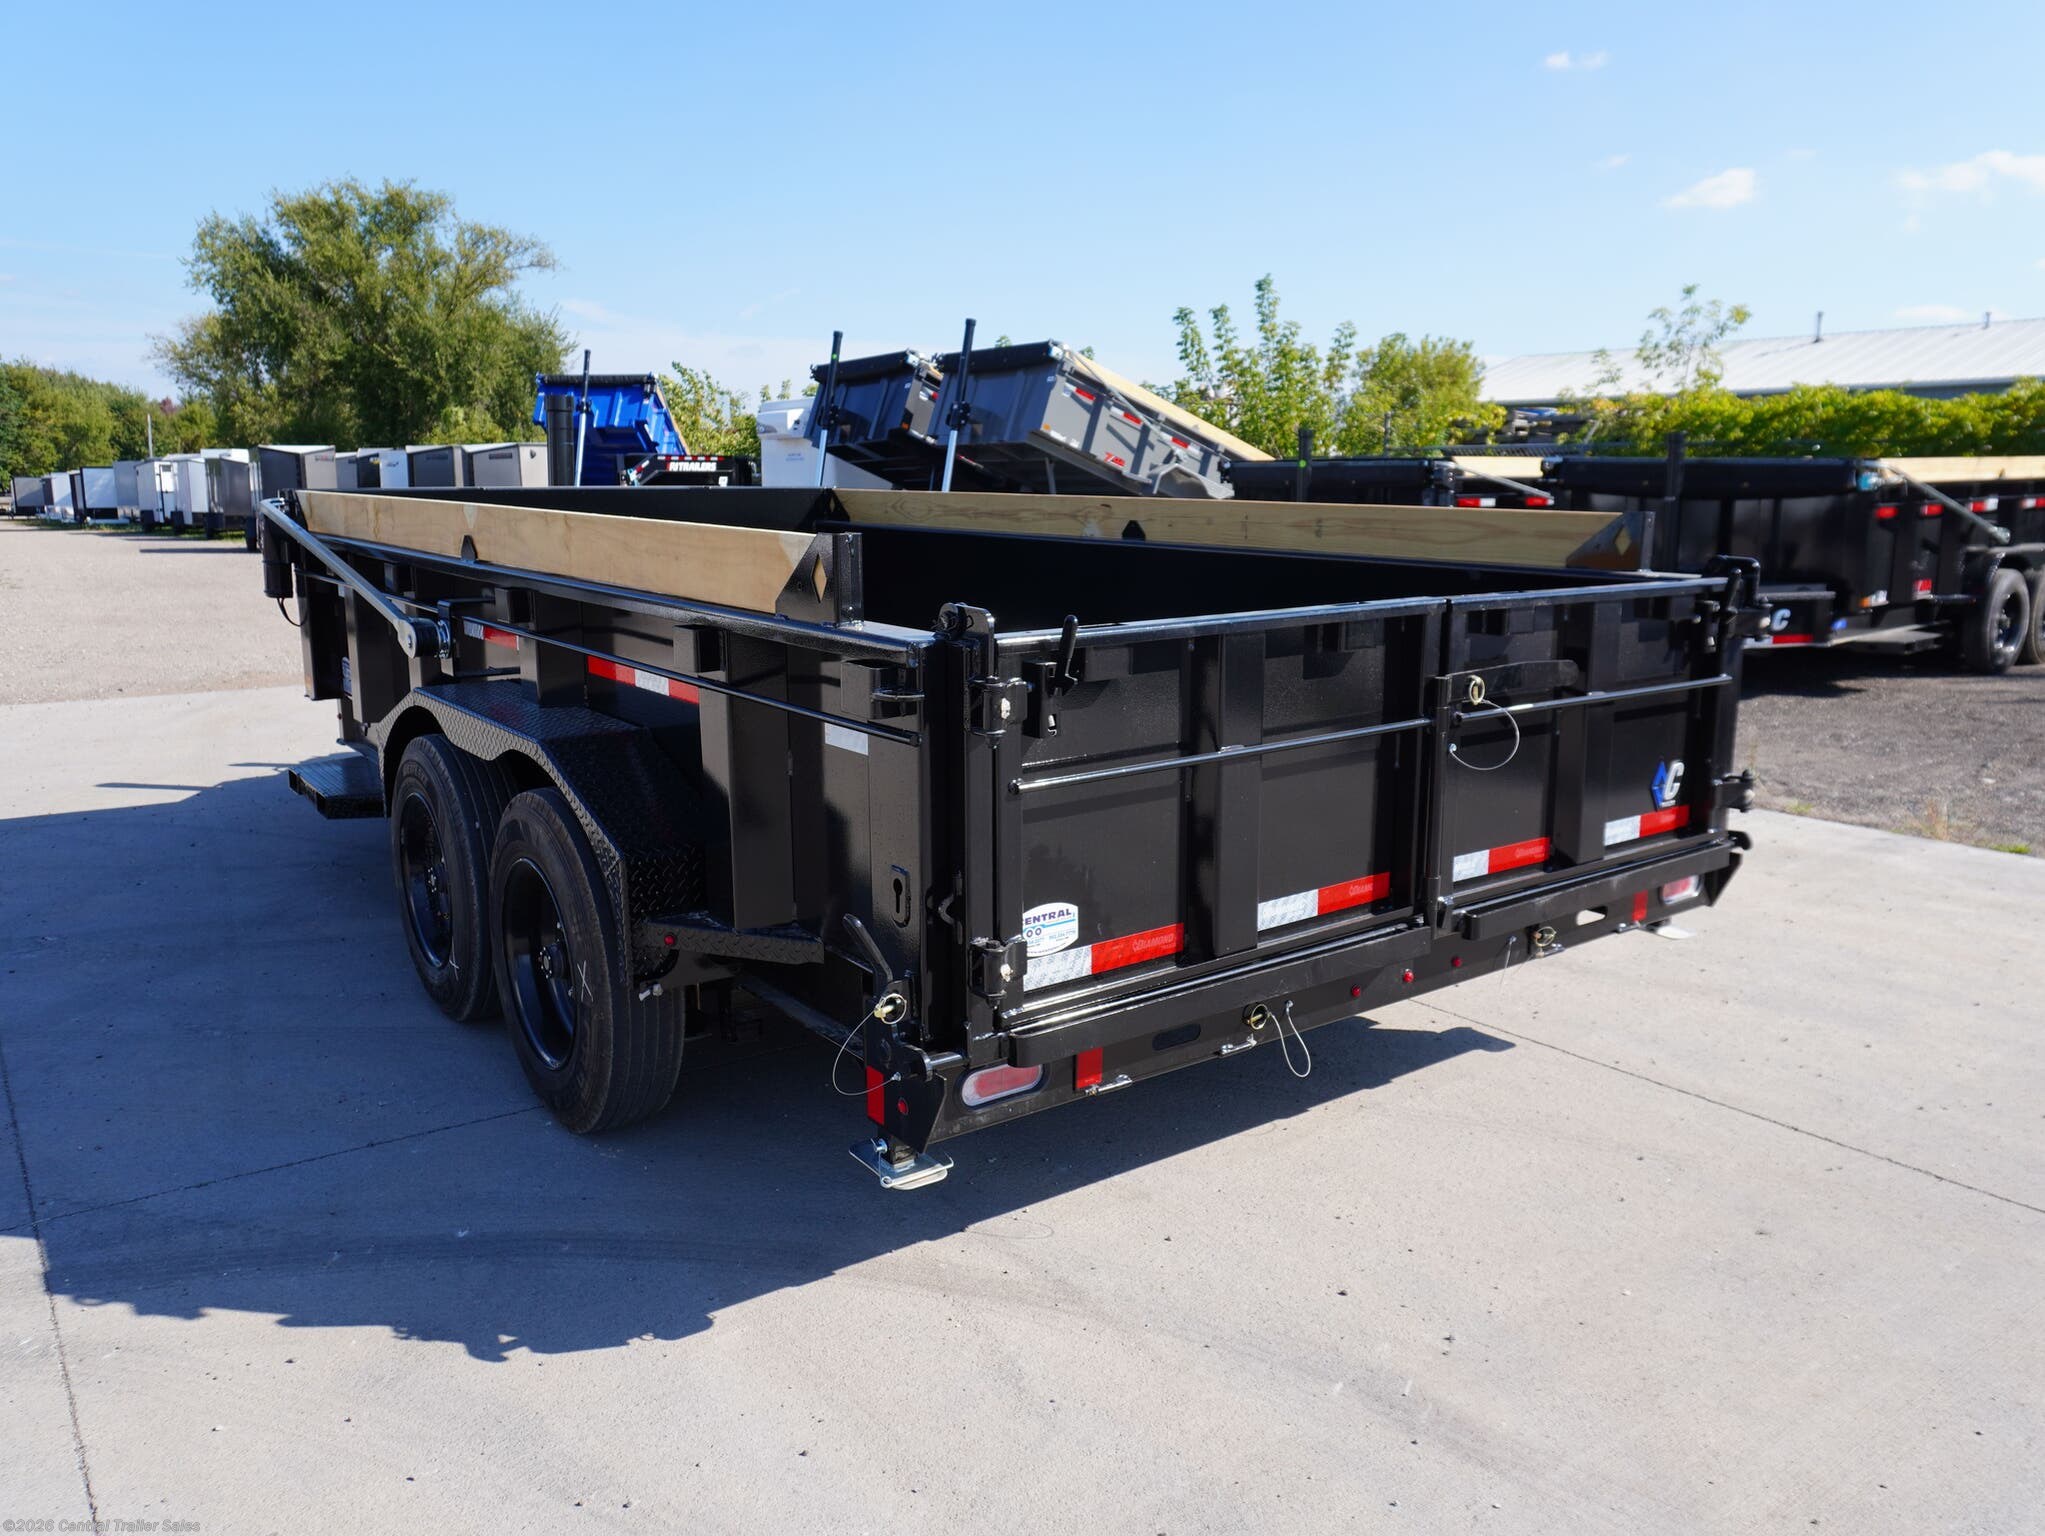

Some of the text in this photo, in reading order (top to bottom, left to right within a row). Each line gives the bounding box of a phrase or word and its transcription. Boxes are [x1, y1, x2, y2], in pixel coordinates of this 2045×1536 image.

[678, 461, 717, 472] TRAILERS
[1664, 761, 1685, 801] C
[1023, 908, 1072, 925] ENTRAL
